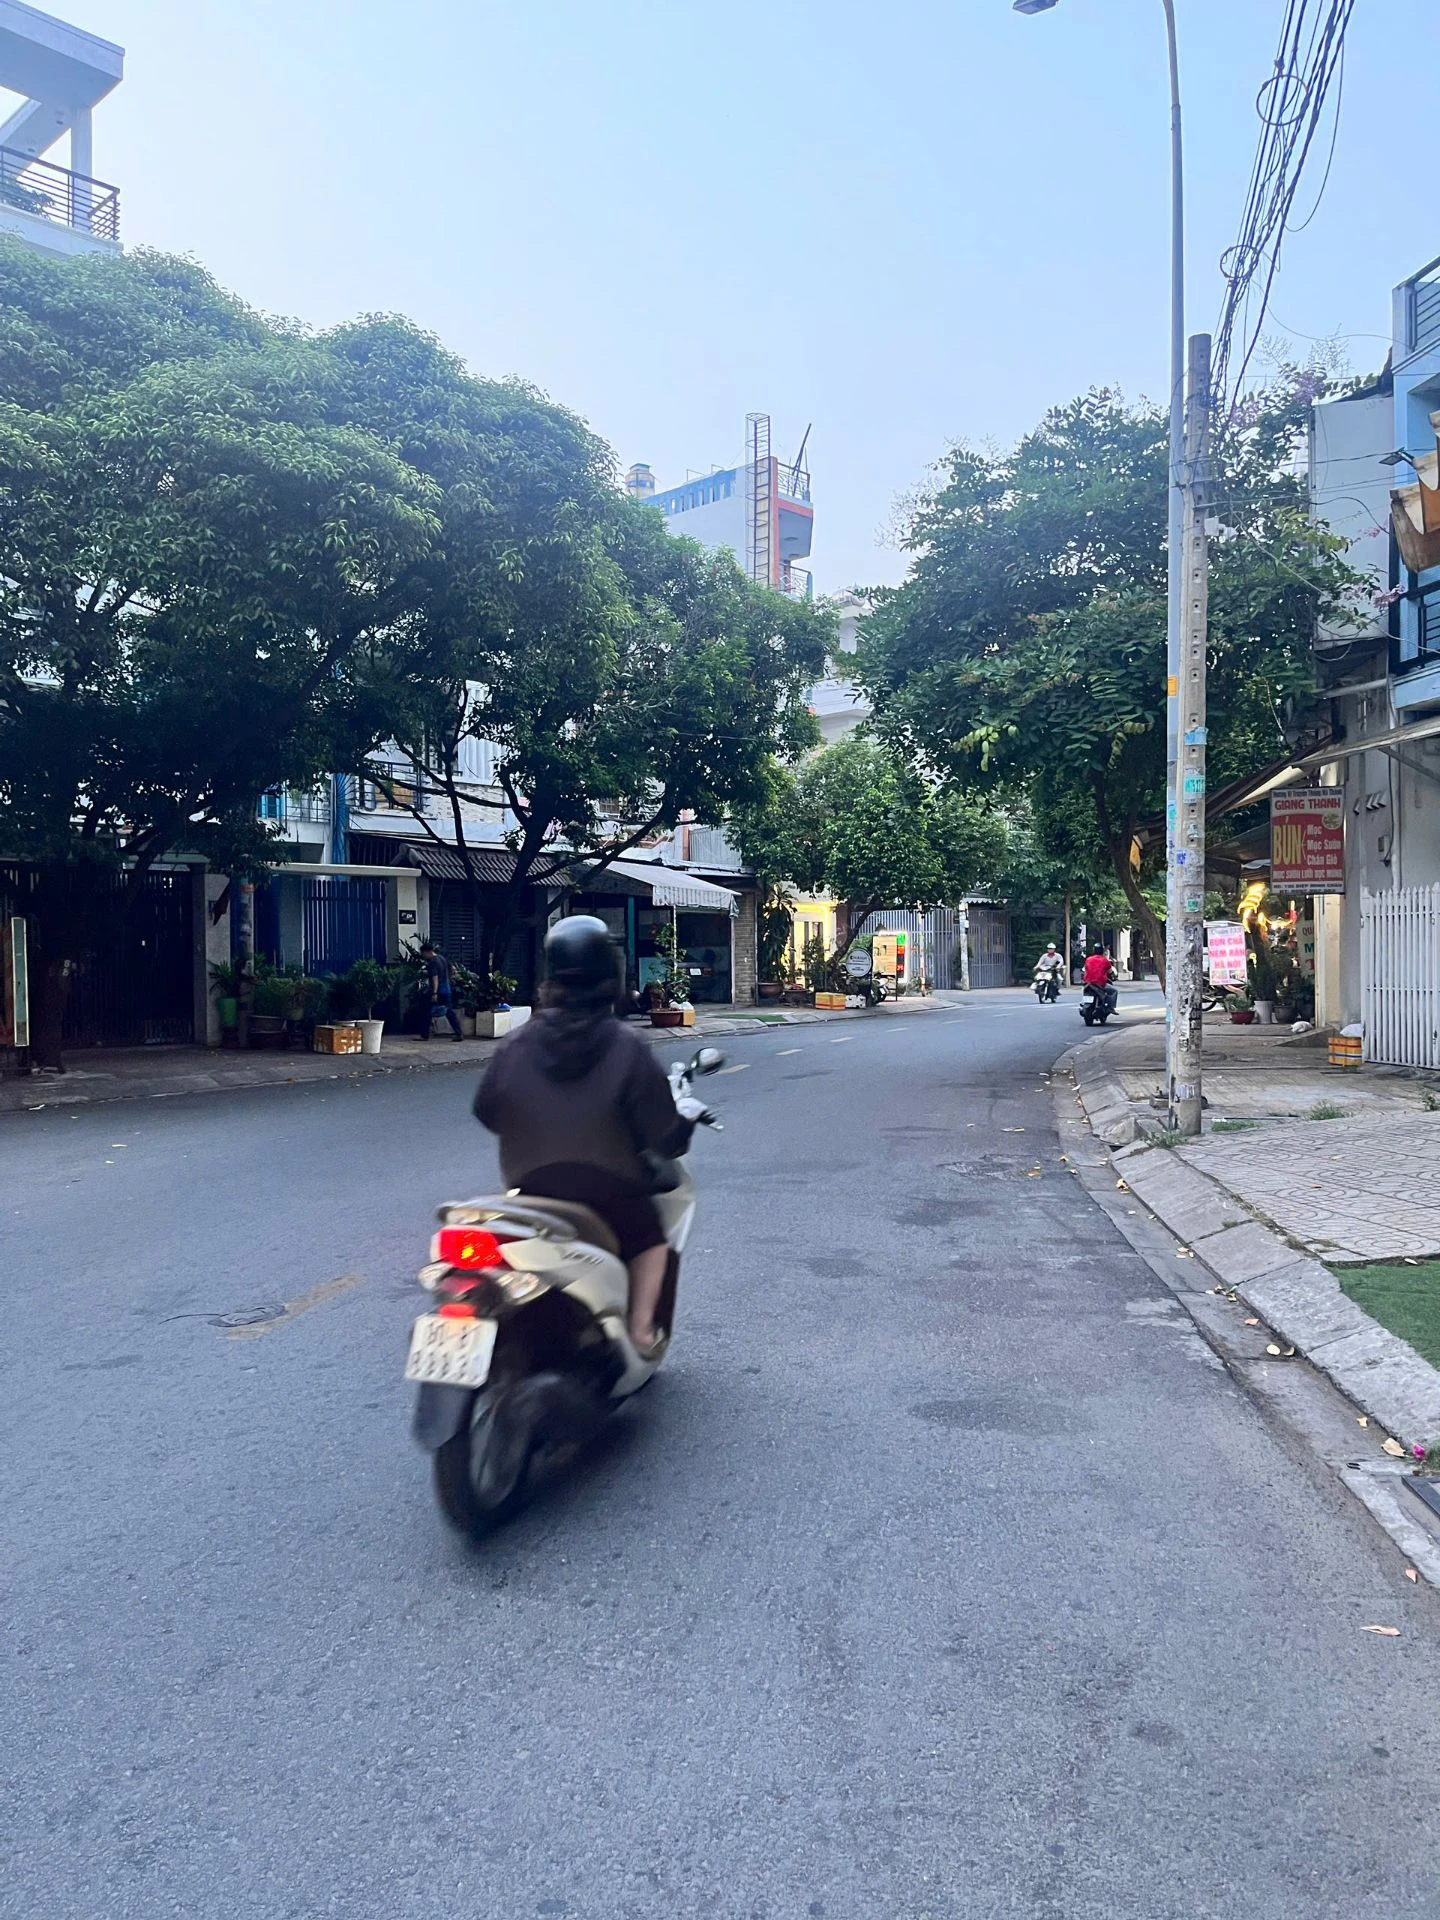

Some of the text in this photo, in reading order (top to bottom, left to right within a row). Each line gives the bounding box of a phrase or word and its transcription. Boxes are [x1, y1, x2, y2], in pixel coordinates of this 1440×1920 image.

[1307, 824, 1322, 837] Mọc
[1273, 816, 1302, 865] BÚN
[1307, 839, 1322, 853] Mọc
